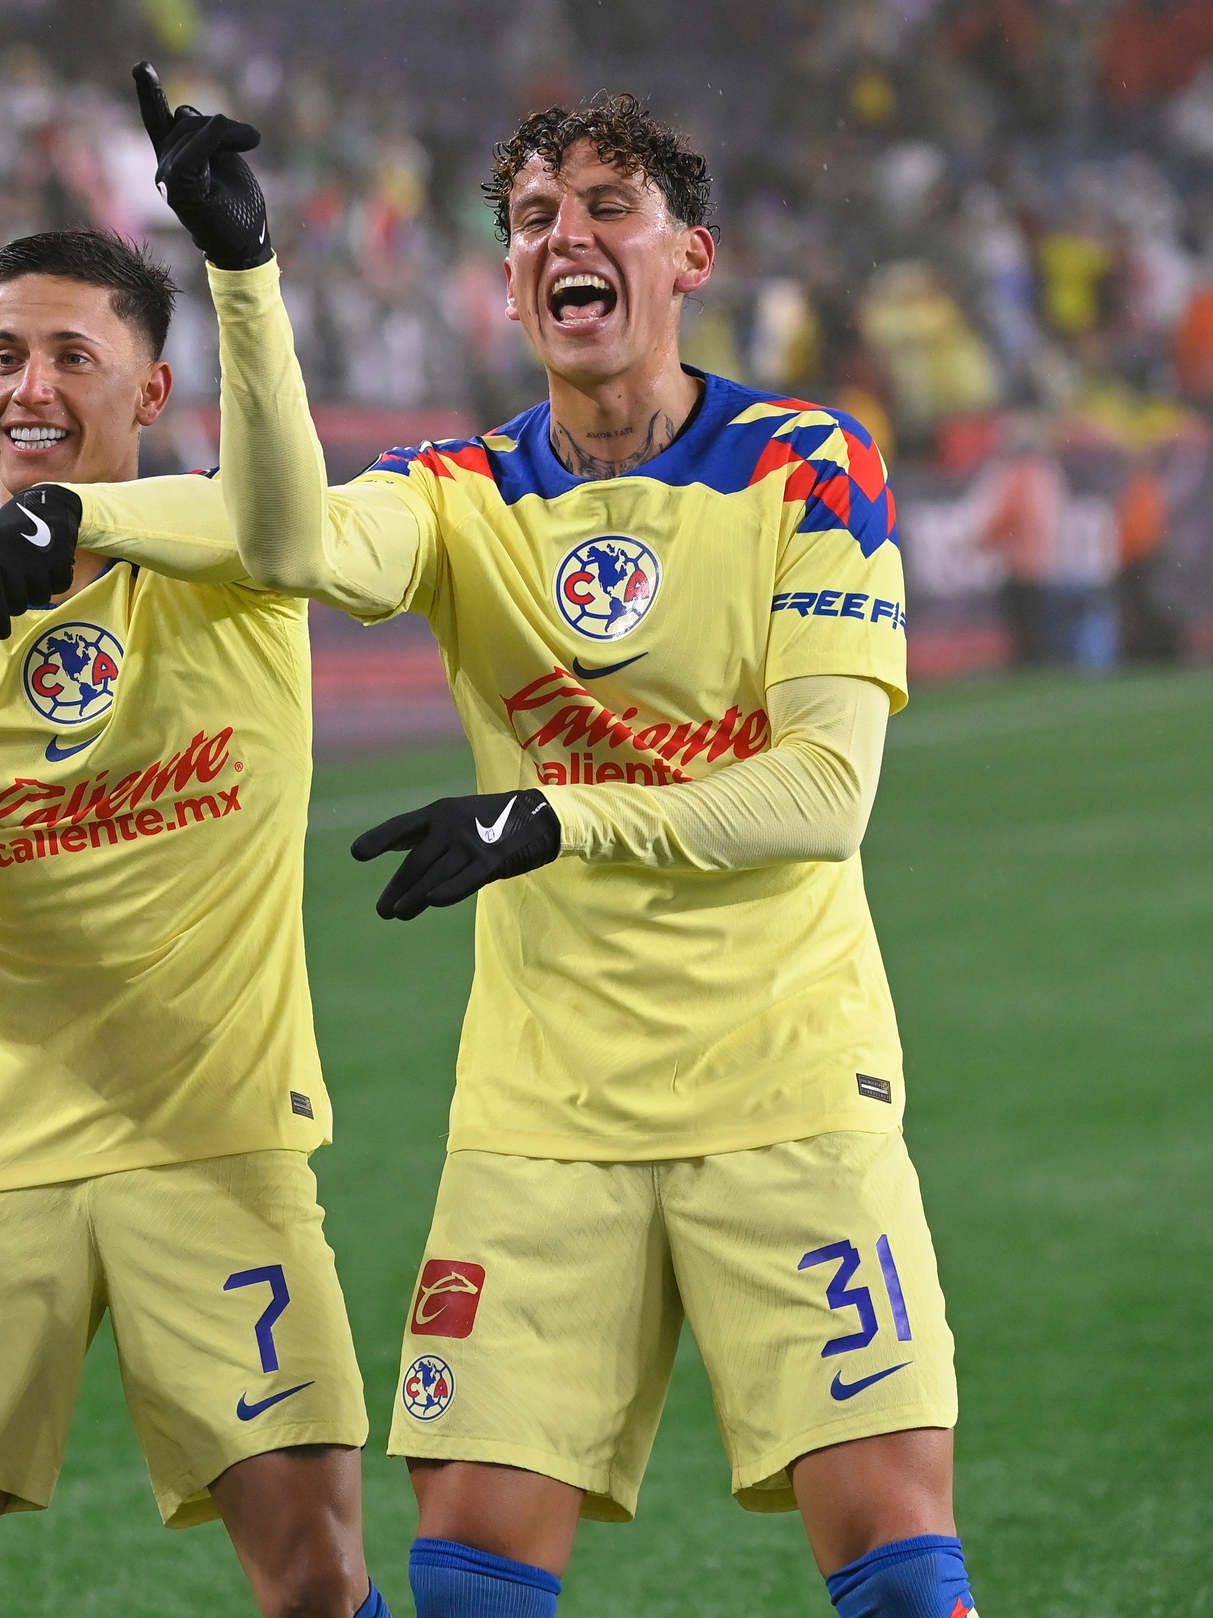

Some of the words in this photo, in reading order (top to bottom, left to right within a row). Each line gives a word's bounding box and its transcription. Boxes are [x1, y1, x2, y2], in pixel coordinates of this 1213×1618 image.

[564, 571, 594, 606] C
[625, 569, 650, 602] A
[31, 664, 64, 697] C
[91, 651, 120, 685] A
[499, 665, 769, 767] Caliente
[223, 1264, 291, 1373] 7
[797, 1234, 913, 1357] 31
[406, 1376, 420, 1399] C
[433, 1378, 448, 1398] A
